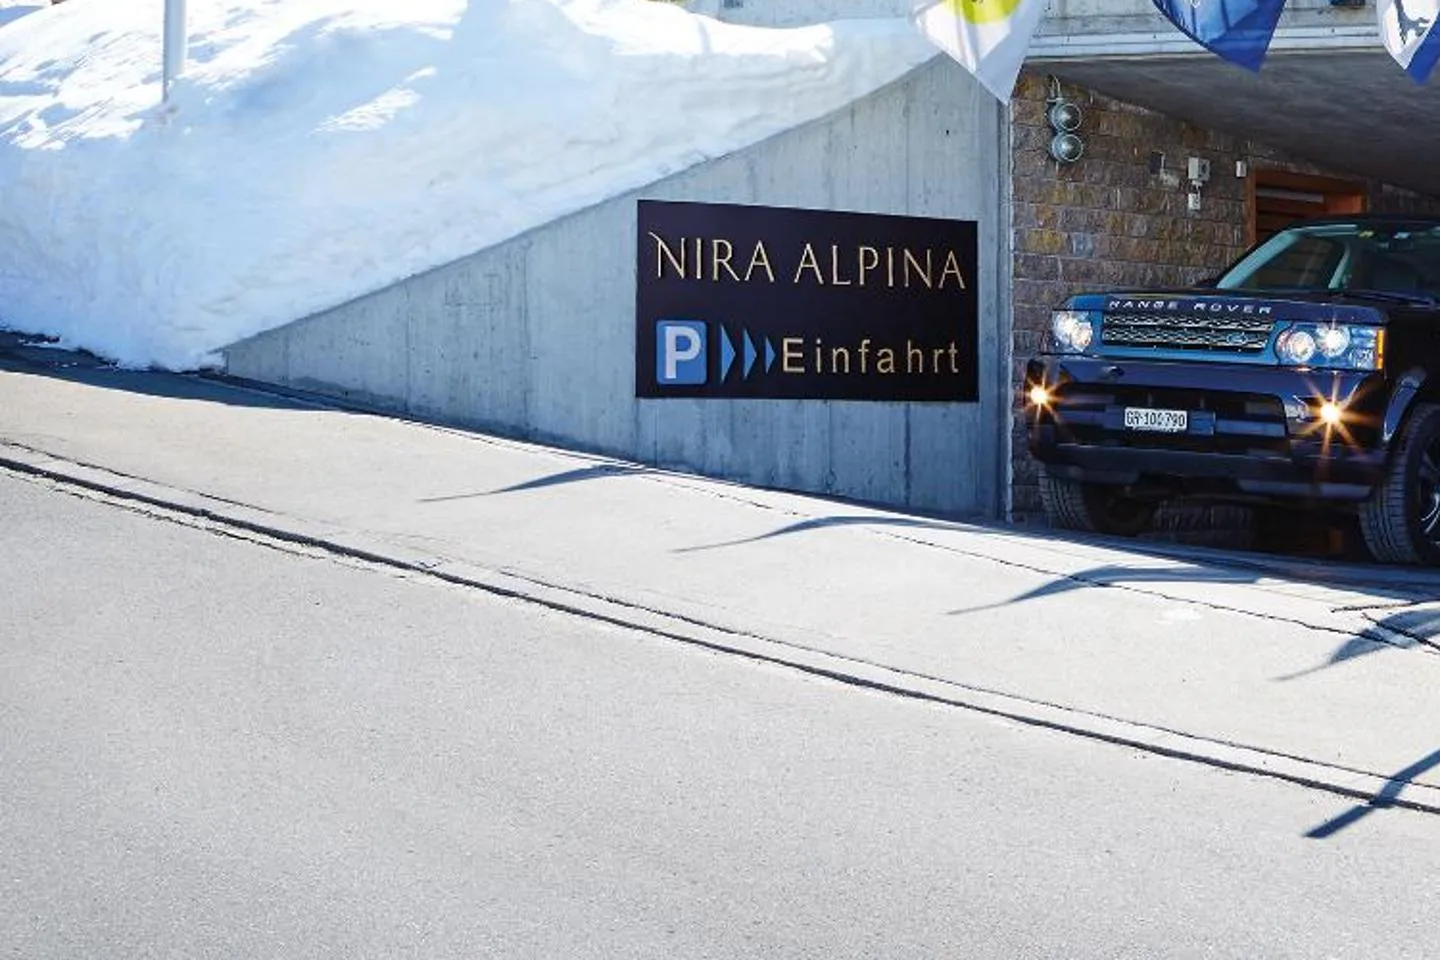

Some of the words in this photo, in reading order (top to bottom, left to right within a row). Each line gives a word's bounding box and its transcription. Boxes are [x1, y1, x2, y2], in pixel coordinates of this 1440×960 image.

[648, 231, 775, 283] NIRA
[794, 243, 967, 290] ALPINA
[1108, 300, 1179, 311] RANGE
[1193, 302, 1272, 315] ROVER
[665, 326, 701, 379] P
[782, 337, 960, 375] Einfahrt
